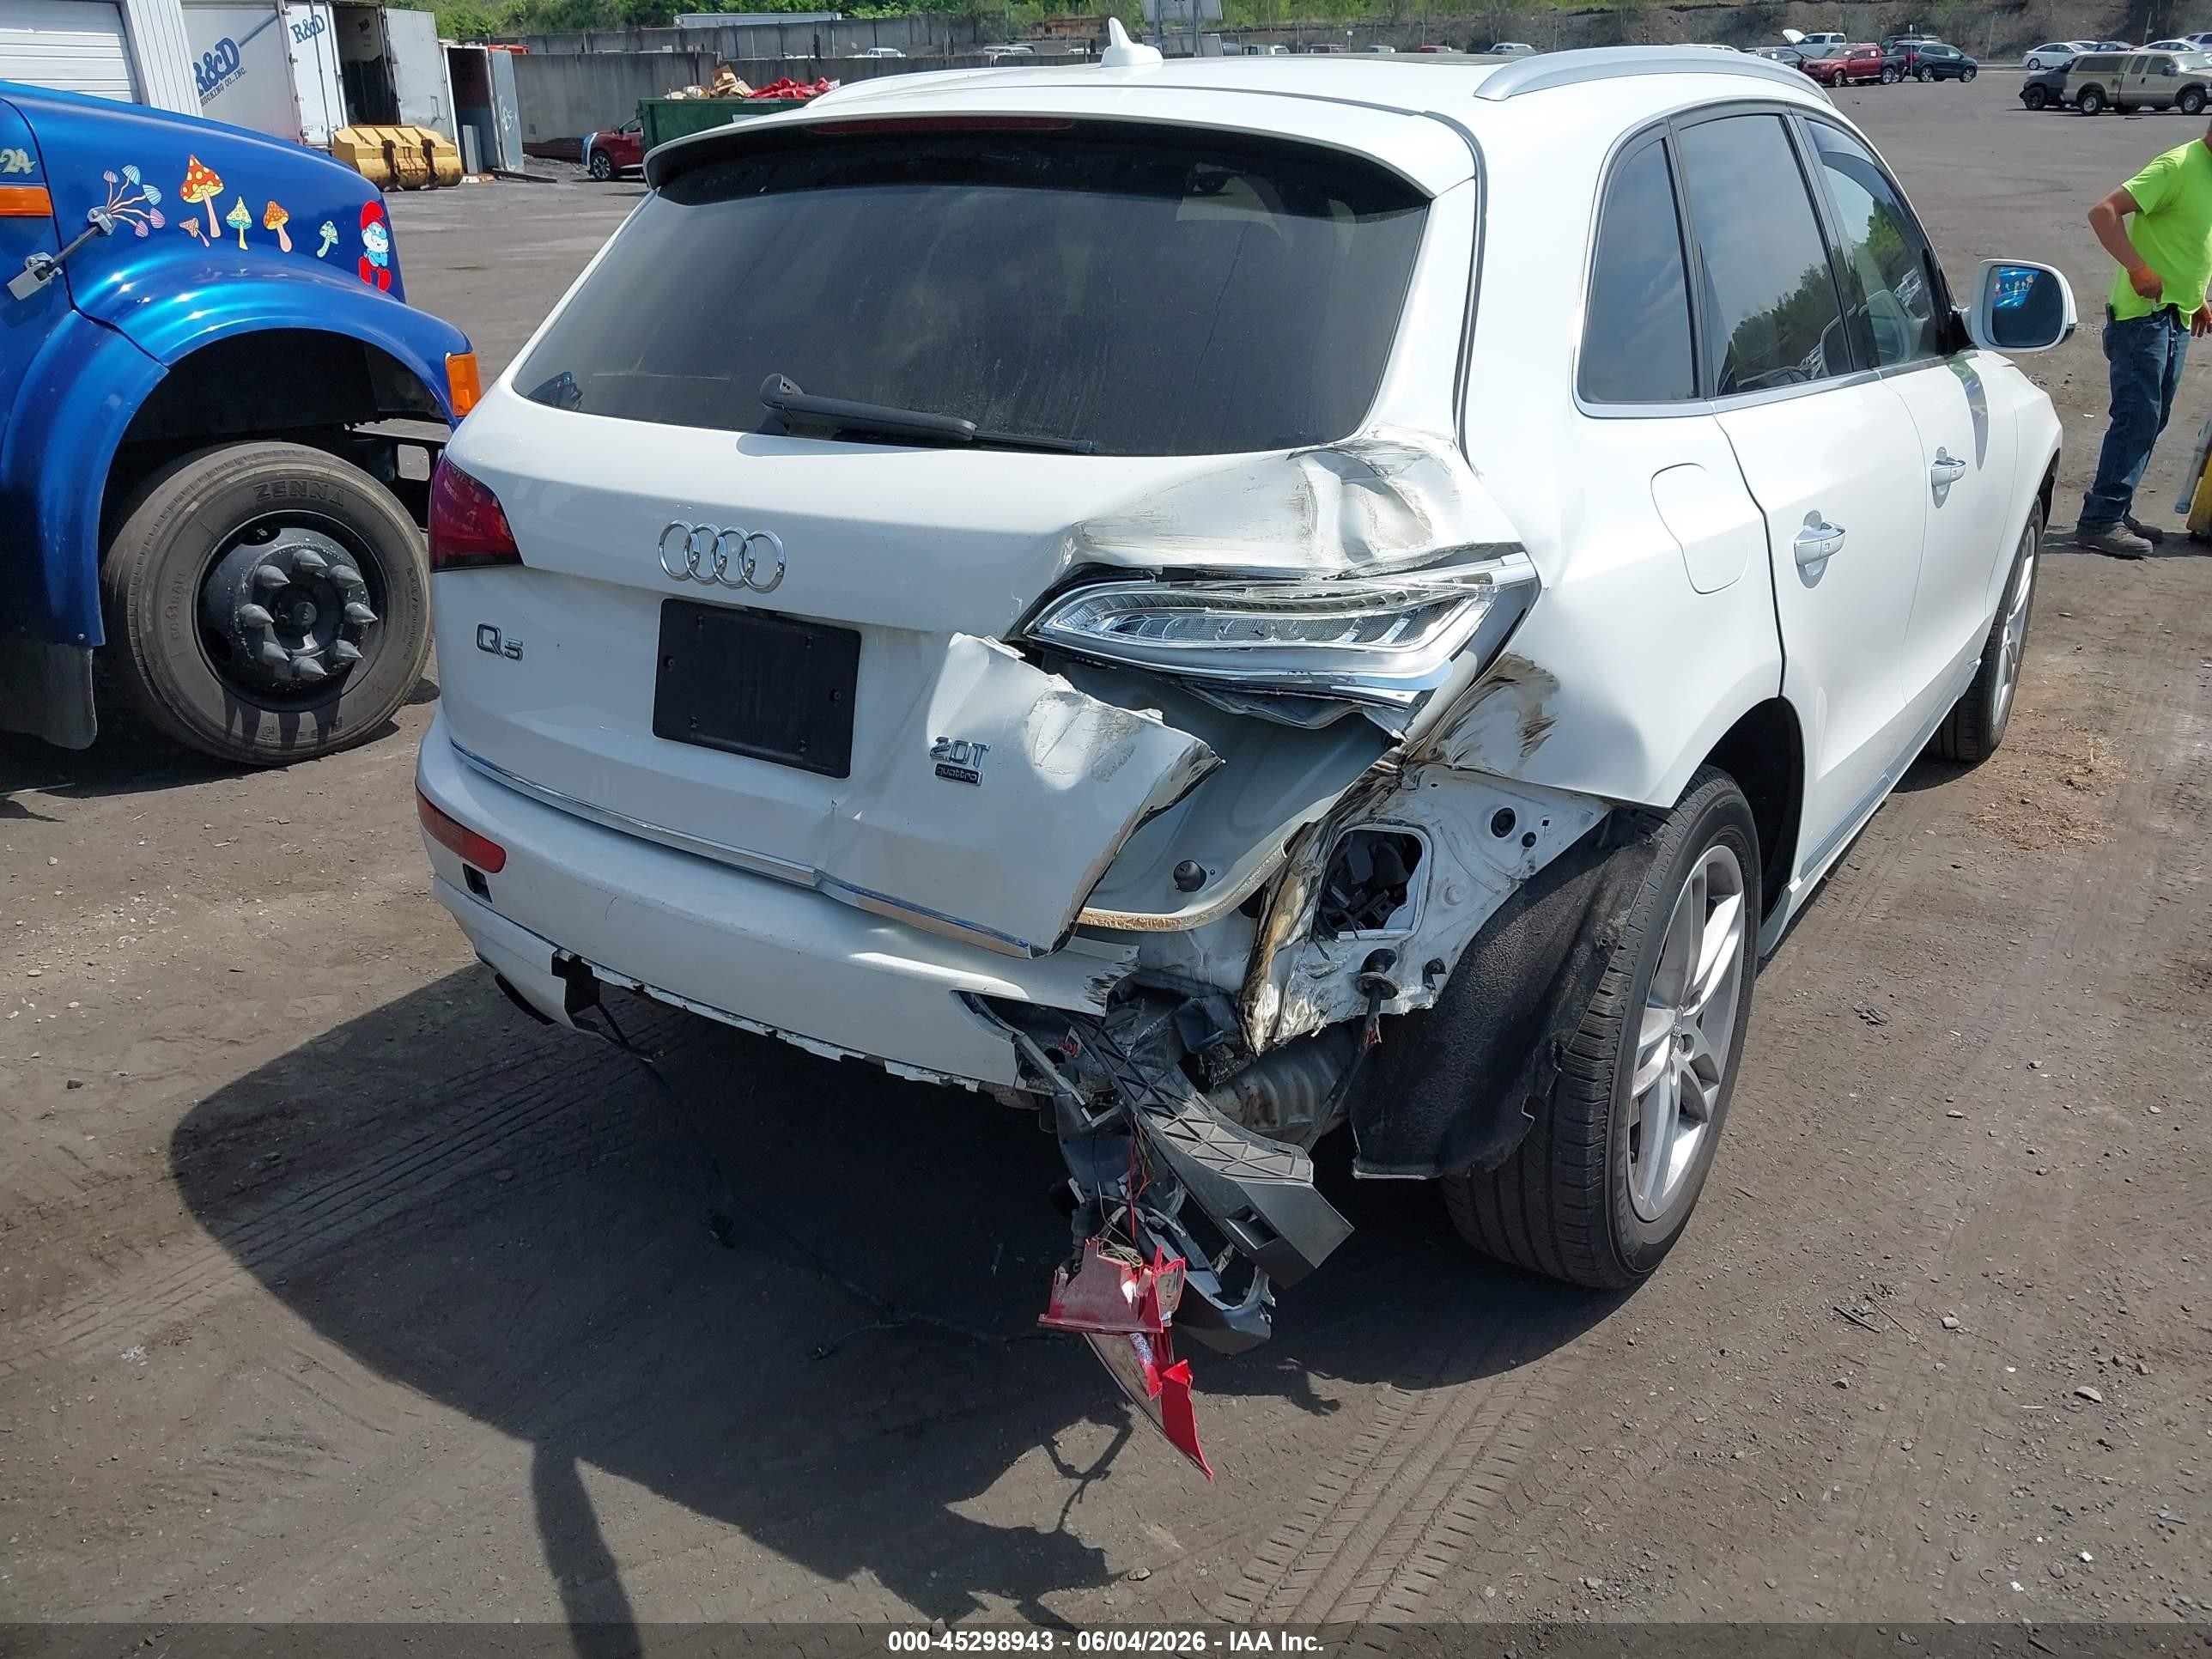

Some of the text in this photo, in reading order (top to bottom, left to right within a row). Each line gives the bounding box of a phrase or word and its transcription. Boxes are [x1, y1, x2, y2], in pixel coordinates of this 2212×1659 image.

[289, 14, 325, 45] R&D
[198, 82, 225, 107] RUCKING
[252, 479, 345, 507] ZENNA
[476, 623, 524, 661] Q5
[929, 736, 991, 769] 2.0T
[936, 765, 978, 781] quattro
